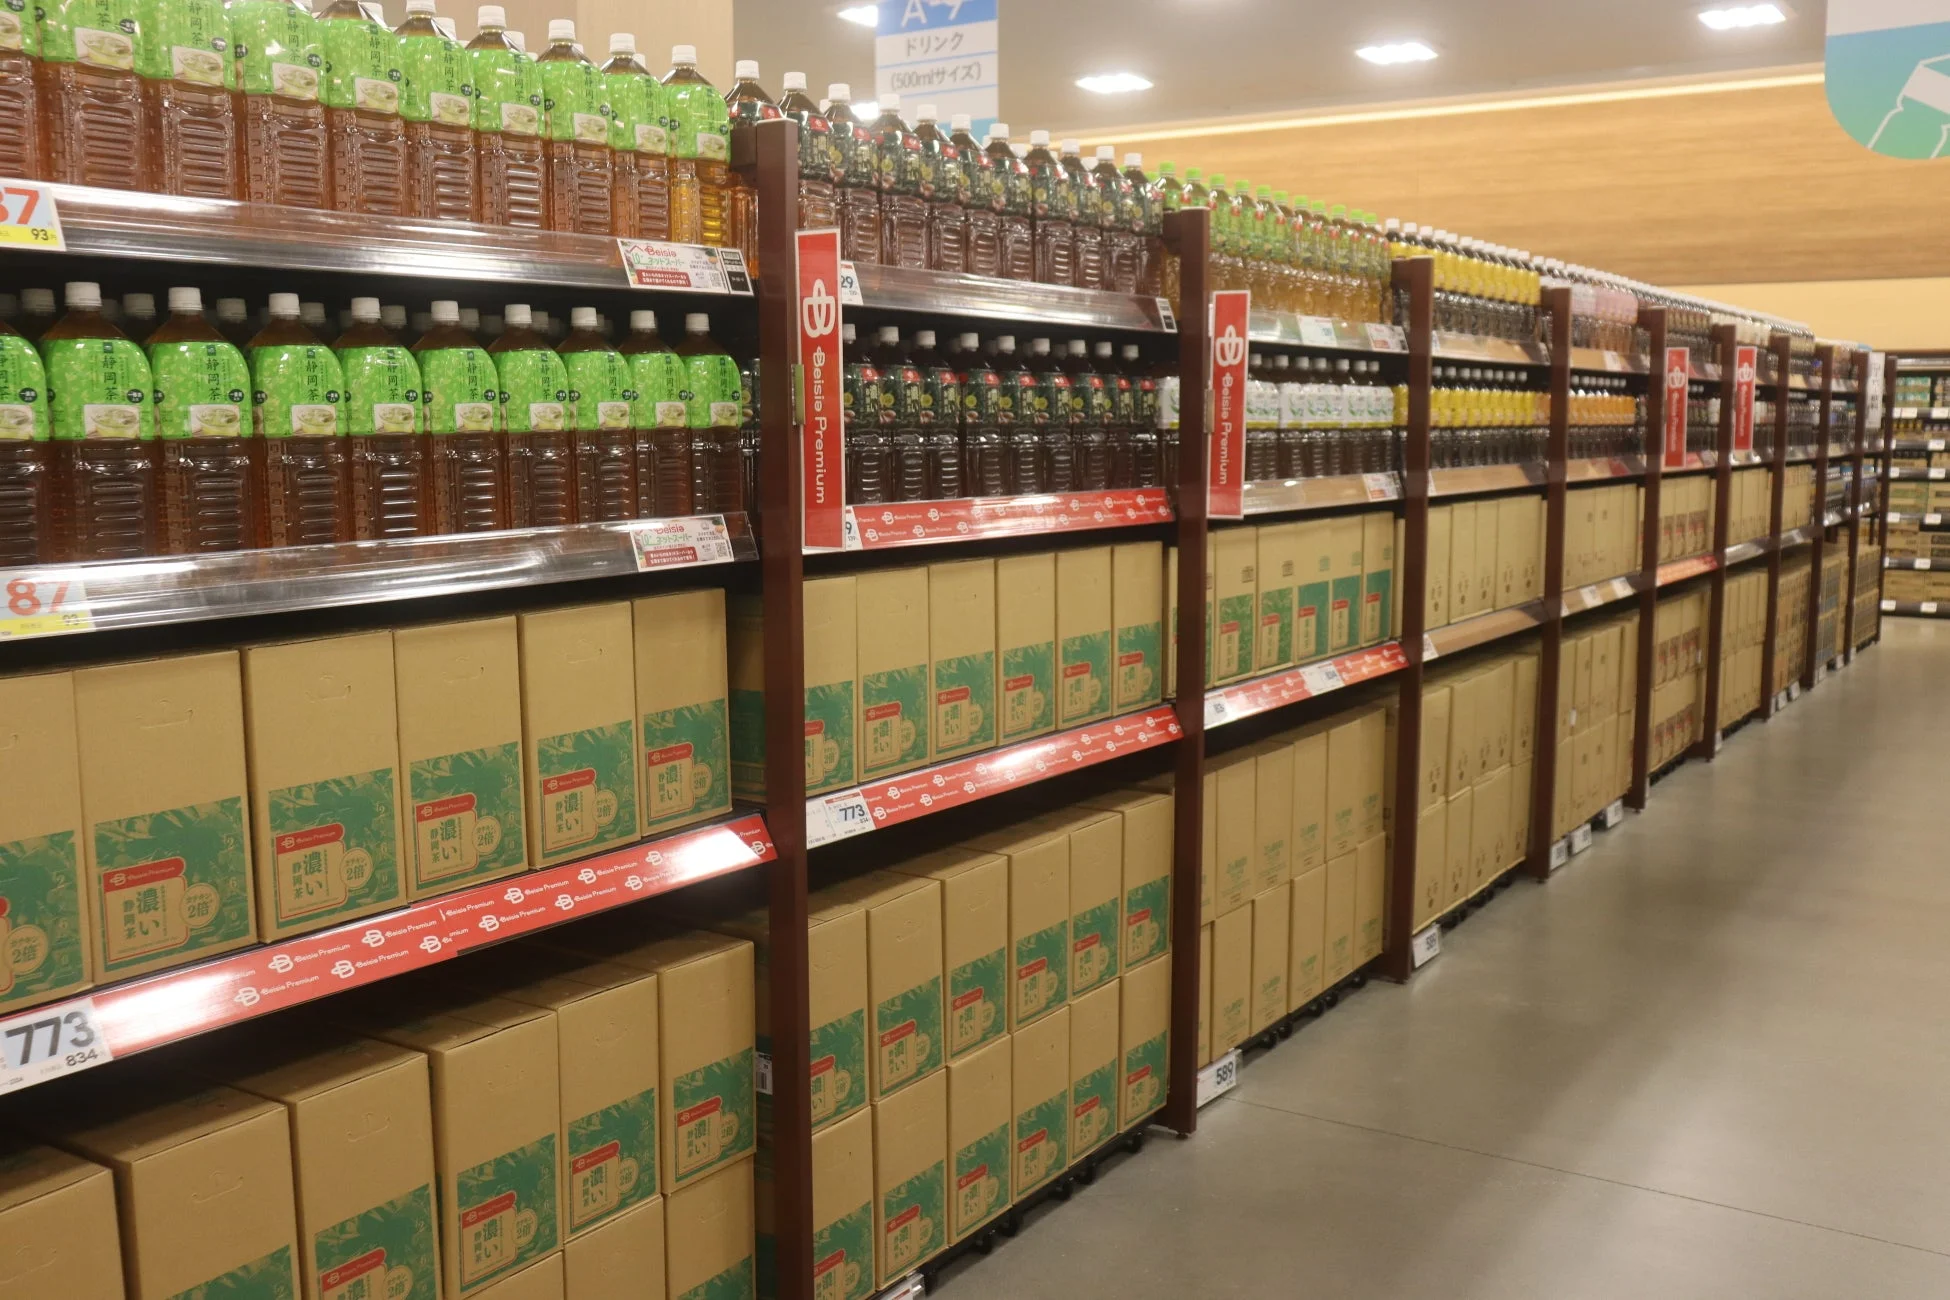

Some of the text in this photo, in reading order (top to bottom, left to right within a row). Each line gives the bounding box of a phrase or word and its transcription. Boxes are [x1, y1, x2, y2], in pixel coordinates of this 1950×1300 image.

[906, 31, 964, 57] ドリンク
[31, 228, 49, 241] 93
[644, 245, 677, 257] Beisia
[102, 357, 118, 401] 静岡茶
[206, 358, 222, 401] 静岡茶
[306, 360, 320, 401] 静岡茶
[467, 363, 478, 400] 静岡茶
[813, 346, 827, 504] Beisia Premium
[1219, 372, 1233, 486] Beisia Premium
[7, 578, 70, 616] 87
[666, 764, 678, 800] 濃い
[564, 792, 579, 830] 濃い
[839, 804, 866, 821] 773
[439, 818, 458, 860] 濃い
[477, 832, 494, 846] 2倍
[303, 851, 323, 895] 濃い
[346, 865, 365, 881] 2倍
[596, 862, 639, 876] Beisia Premium
[524, 879, 571, 896] Beisia Premium
[574, 887, 618, 902] Beisia Premium
[136, 887, 160, 936] 濃い
[188, 902, 210, 919] 2倍
[446, 899, 495, 917] Beisia Premium
[499, 906, 547, 924] Beisia Premium
[385, 919, 437, 938] Beisia Premium
[12, 945, 37, 963] 2倍
[294, 943, 351, 964] Beisia Premium
[355, 950, 409, 970] Beisia Premium
[261, 975, 320, 996] Beisia Premium
[4, 1011, 95, 1066] 773
[65, 1048, 98, 1067] 834
[1216, 1060, 1234, 1085] 589
[483, 1219, 498, 1258] 濃い
